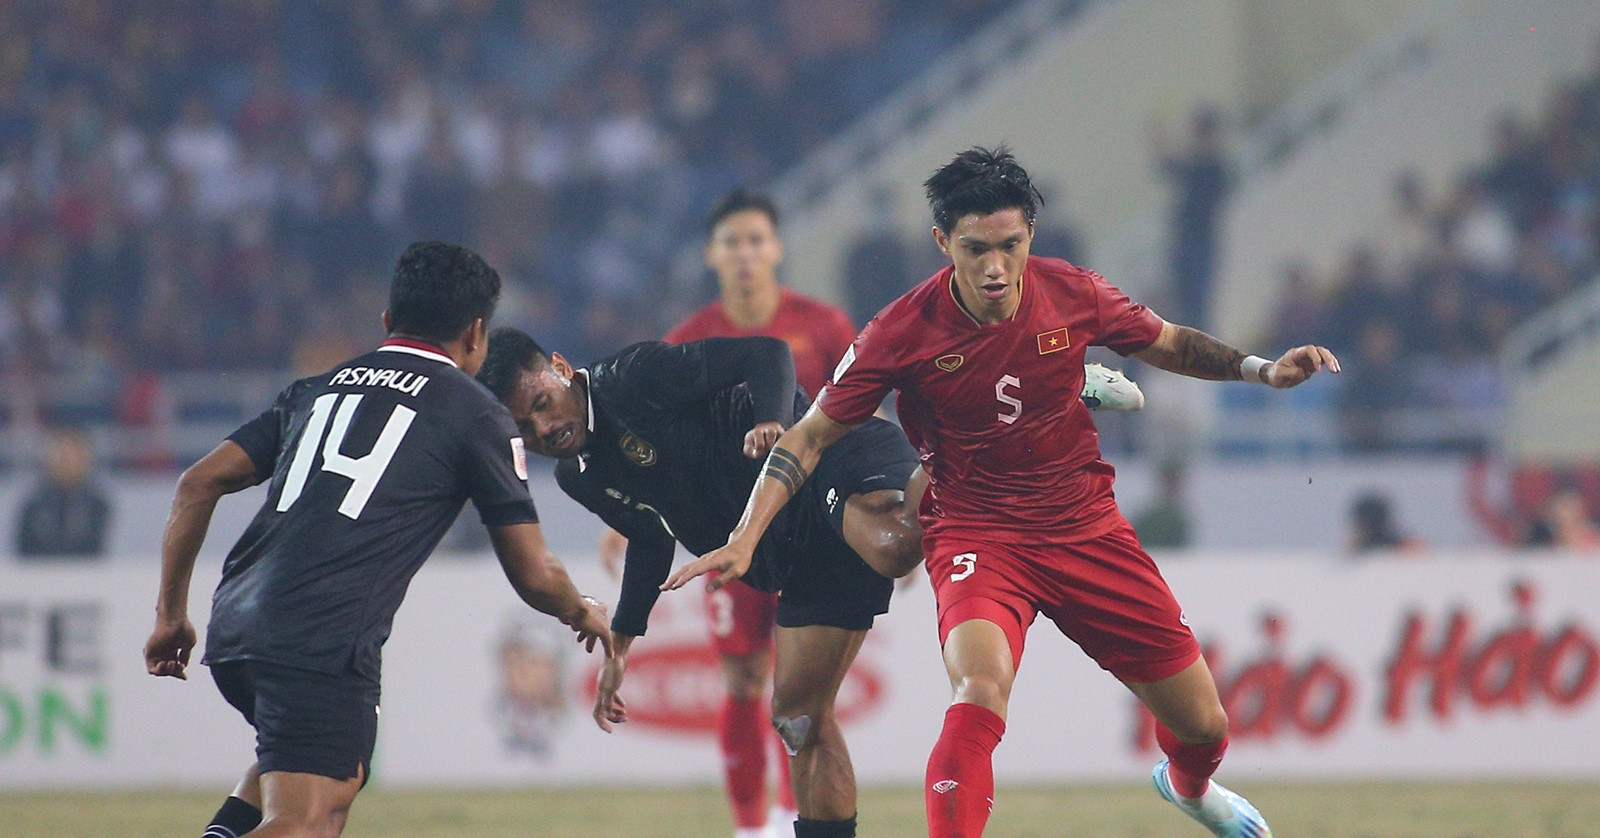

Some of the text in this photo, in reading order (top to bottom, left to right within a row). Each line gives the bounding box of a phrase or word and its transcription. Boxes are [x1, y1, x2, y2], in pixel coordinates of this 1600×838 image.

[328, 366, 430, 398] ASNAWI
[995, 373, 1023, 426] 5
[275, 392, 418, 521] 14
[950, 552, 978, 583] 5
